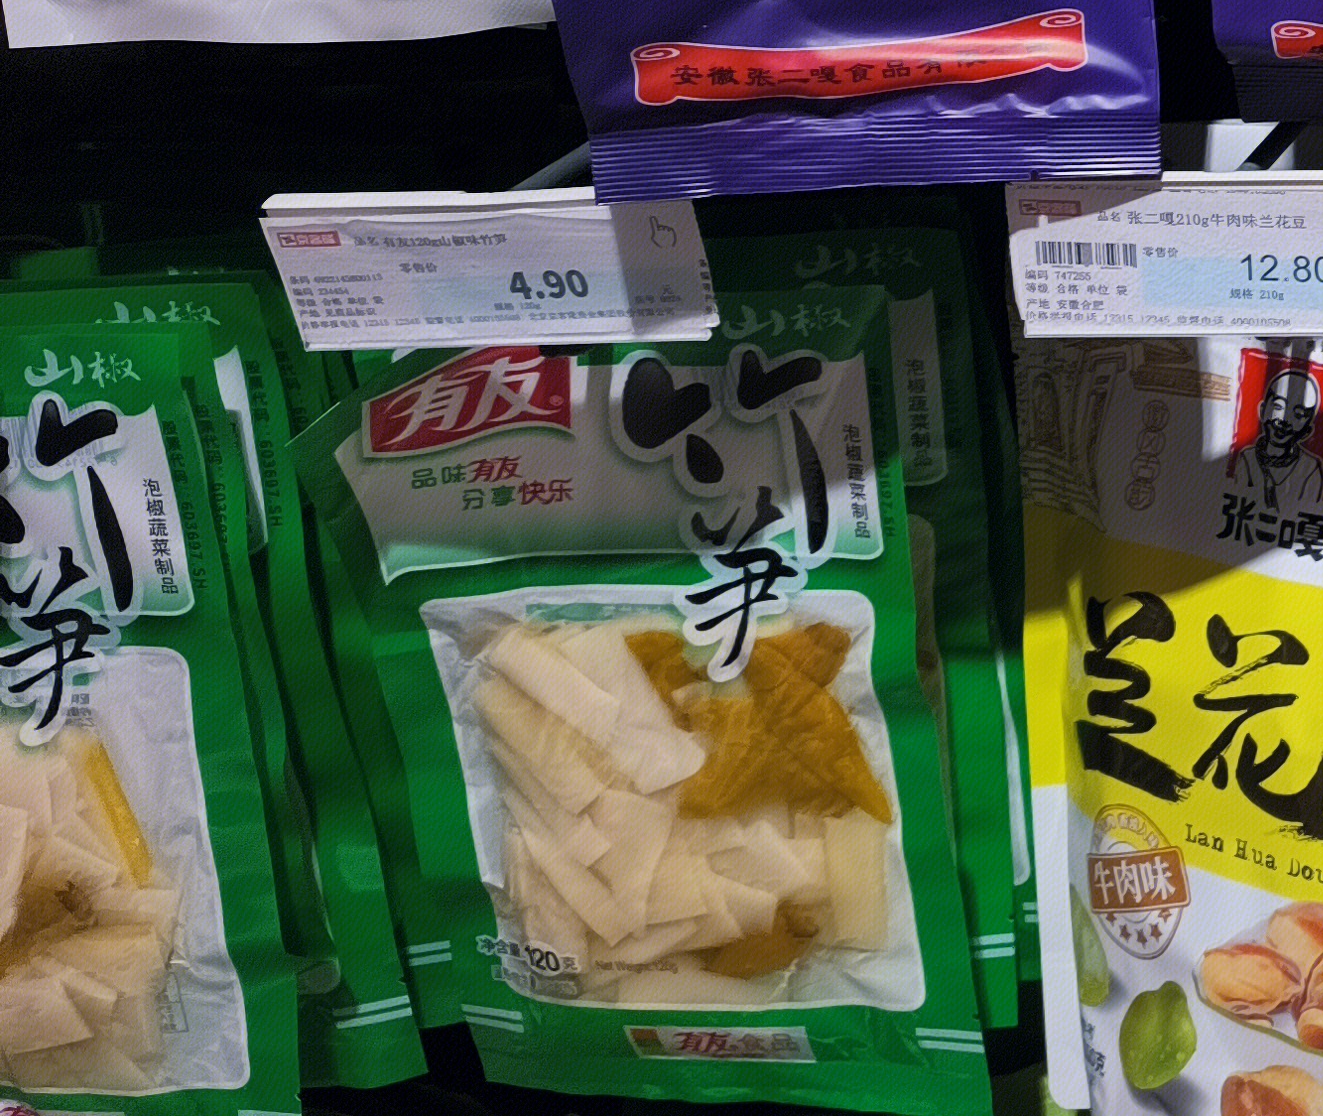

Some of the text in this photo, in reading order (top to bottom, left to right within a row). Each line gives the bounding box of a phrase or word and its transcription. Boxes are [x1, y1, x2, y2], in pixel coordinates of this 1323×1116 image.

[1098, 210, 1306, 230] 品名 张二嘎210g牛肉味兰花豆
[510, 269, 589, 300] 4.90
[1260, 289, 1284, 301] 210g
[1057, 299, 1104, 310] 安徽合肥
[722, 305, 850, 340] 山椒
[24, 348, 141, 388] 山椒
[375, 355, 562, 447] 有友
[411, 455, 523, 491] 品味有友
[461, 479, 573, 512] 分享快乐
[621, 348, 831, 668] 竹笋
[143, 477, 179, 595] 泡椒蔬菜制品
[1184, 823, 1225, 855] Lan
[1234, 839, 1278, 872] Hua
